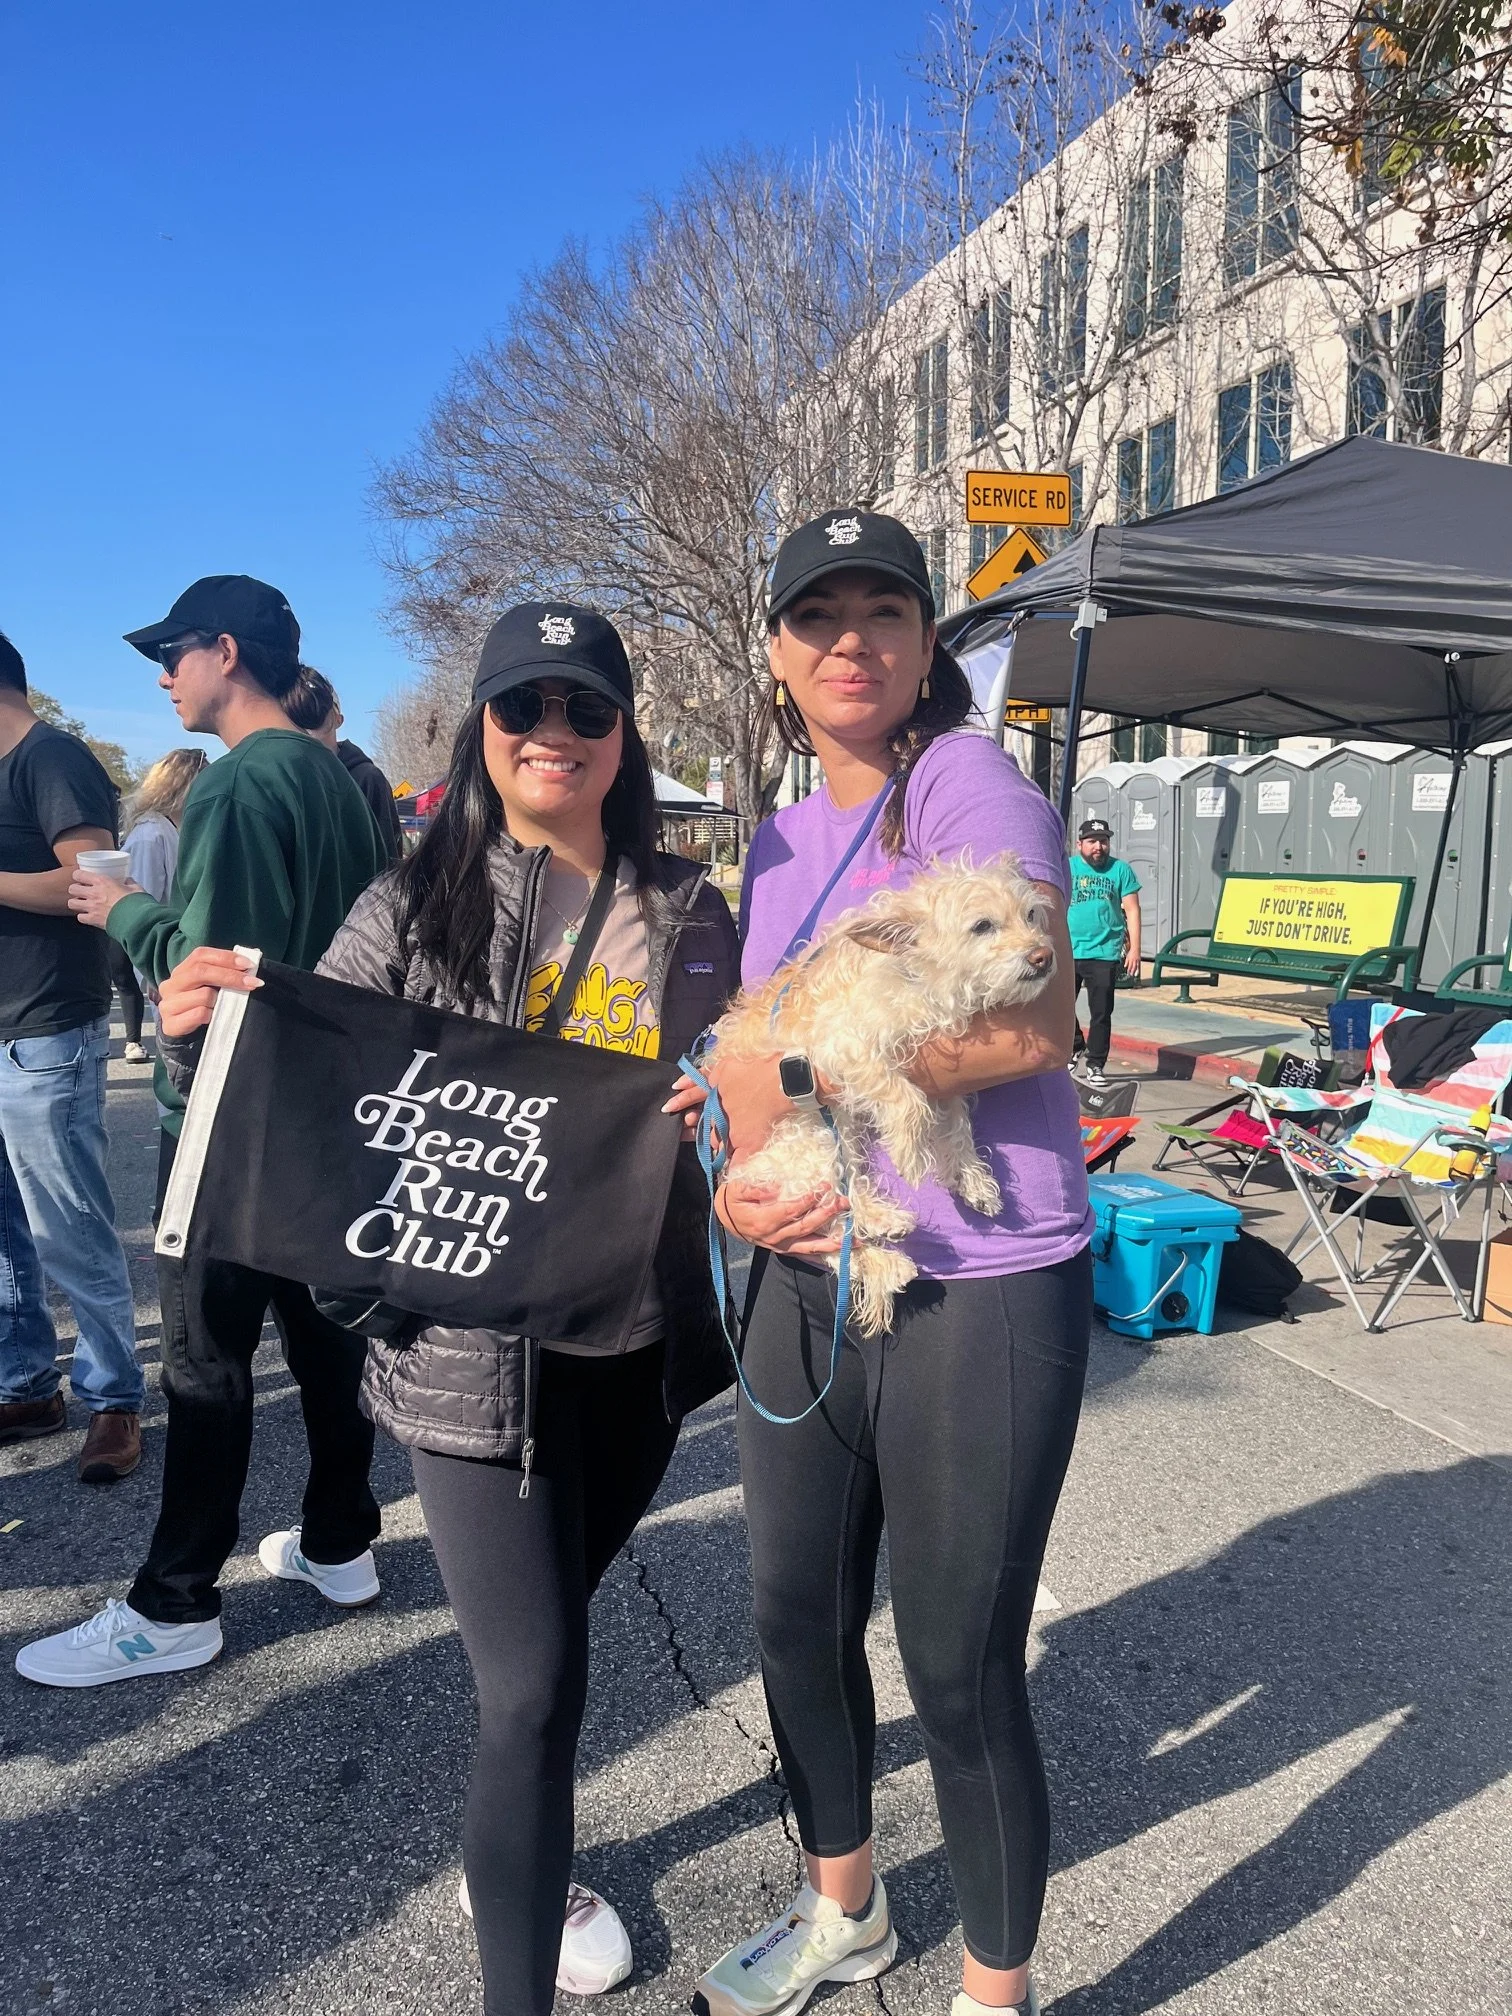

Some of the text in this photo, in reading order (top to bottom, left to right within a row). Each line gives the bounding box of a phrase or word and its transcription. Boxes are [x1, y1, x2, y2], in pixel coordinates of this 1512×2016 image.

[972, 487, 1066, 509] SERVICE RD
[538, 621, 575, 635] Beach
[544, 613, 573, 626] Long
[1273, 884, 1305, 894] PRETTY
[1259, 897, 1347, 921] IF YOU'RE HIGH,
[1246, 919, 1274, 936] JUST
[1275, 921, 1312, 941] DON'T
[1313, 925, 1352, 945] DRIVE.
[387, 1048, 559, 1142] Long
[354, 1093, 548, 1202] Beach
[375, 1157, 510, 1247] Run
[345, 1207, 492, 1278] Club
[116, 1633, 157, 1662] N
